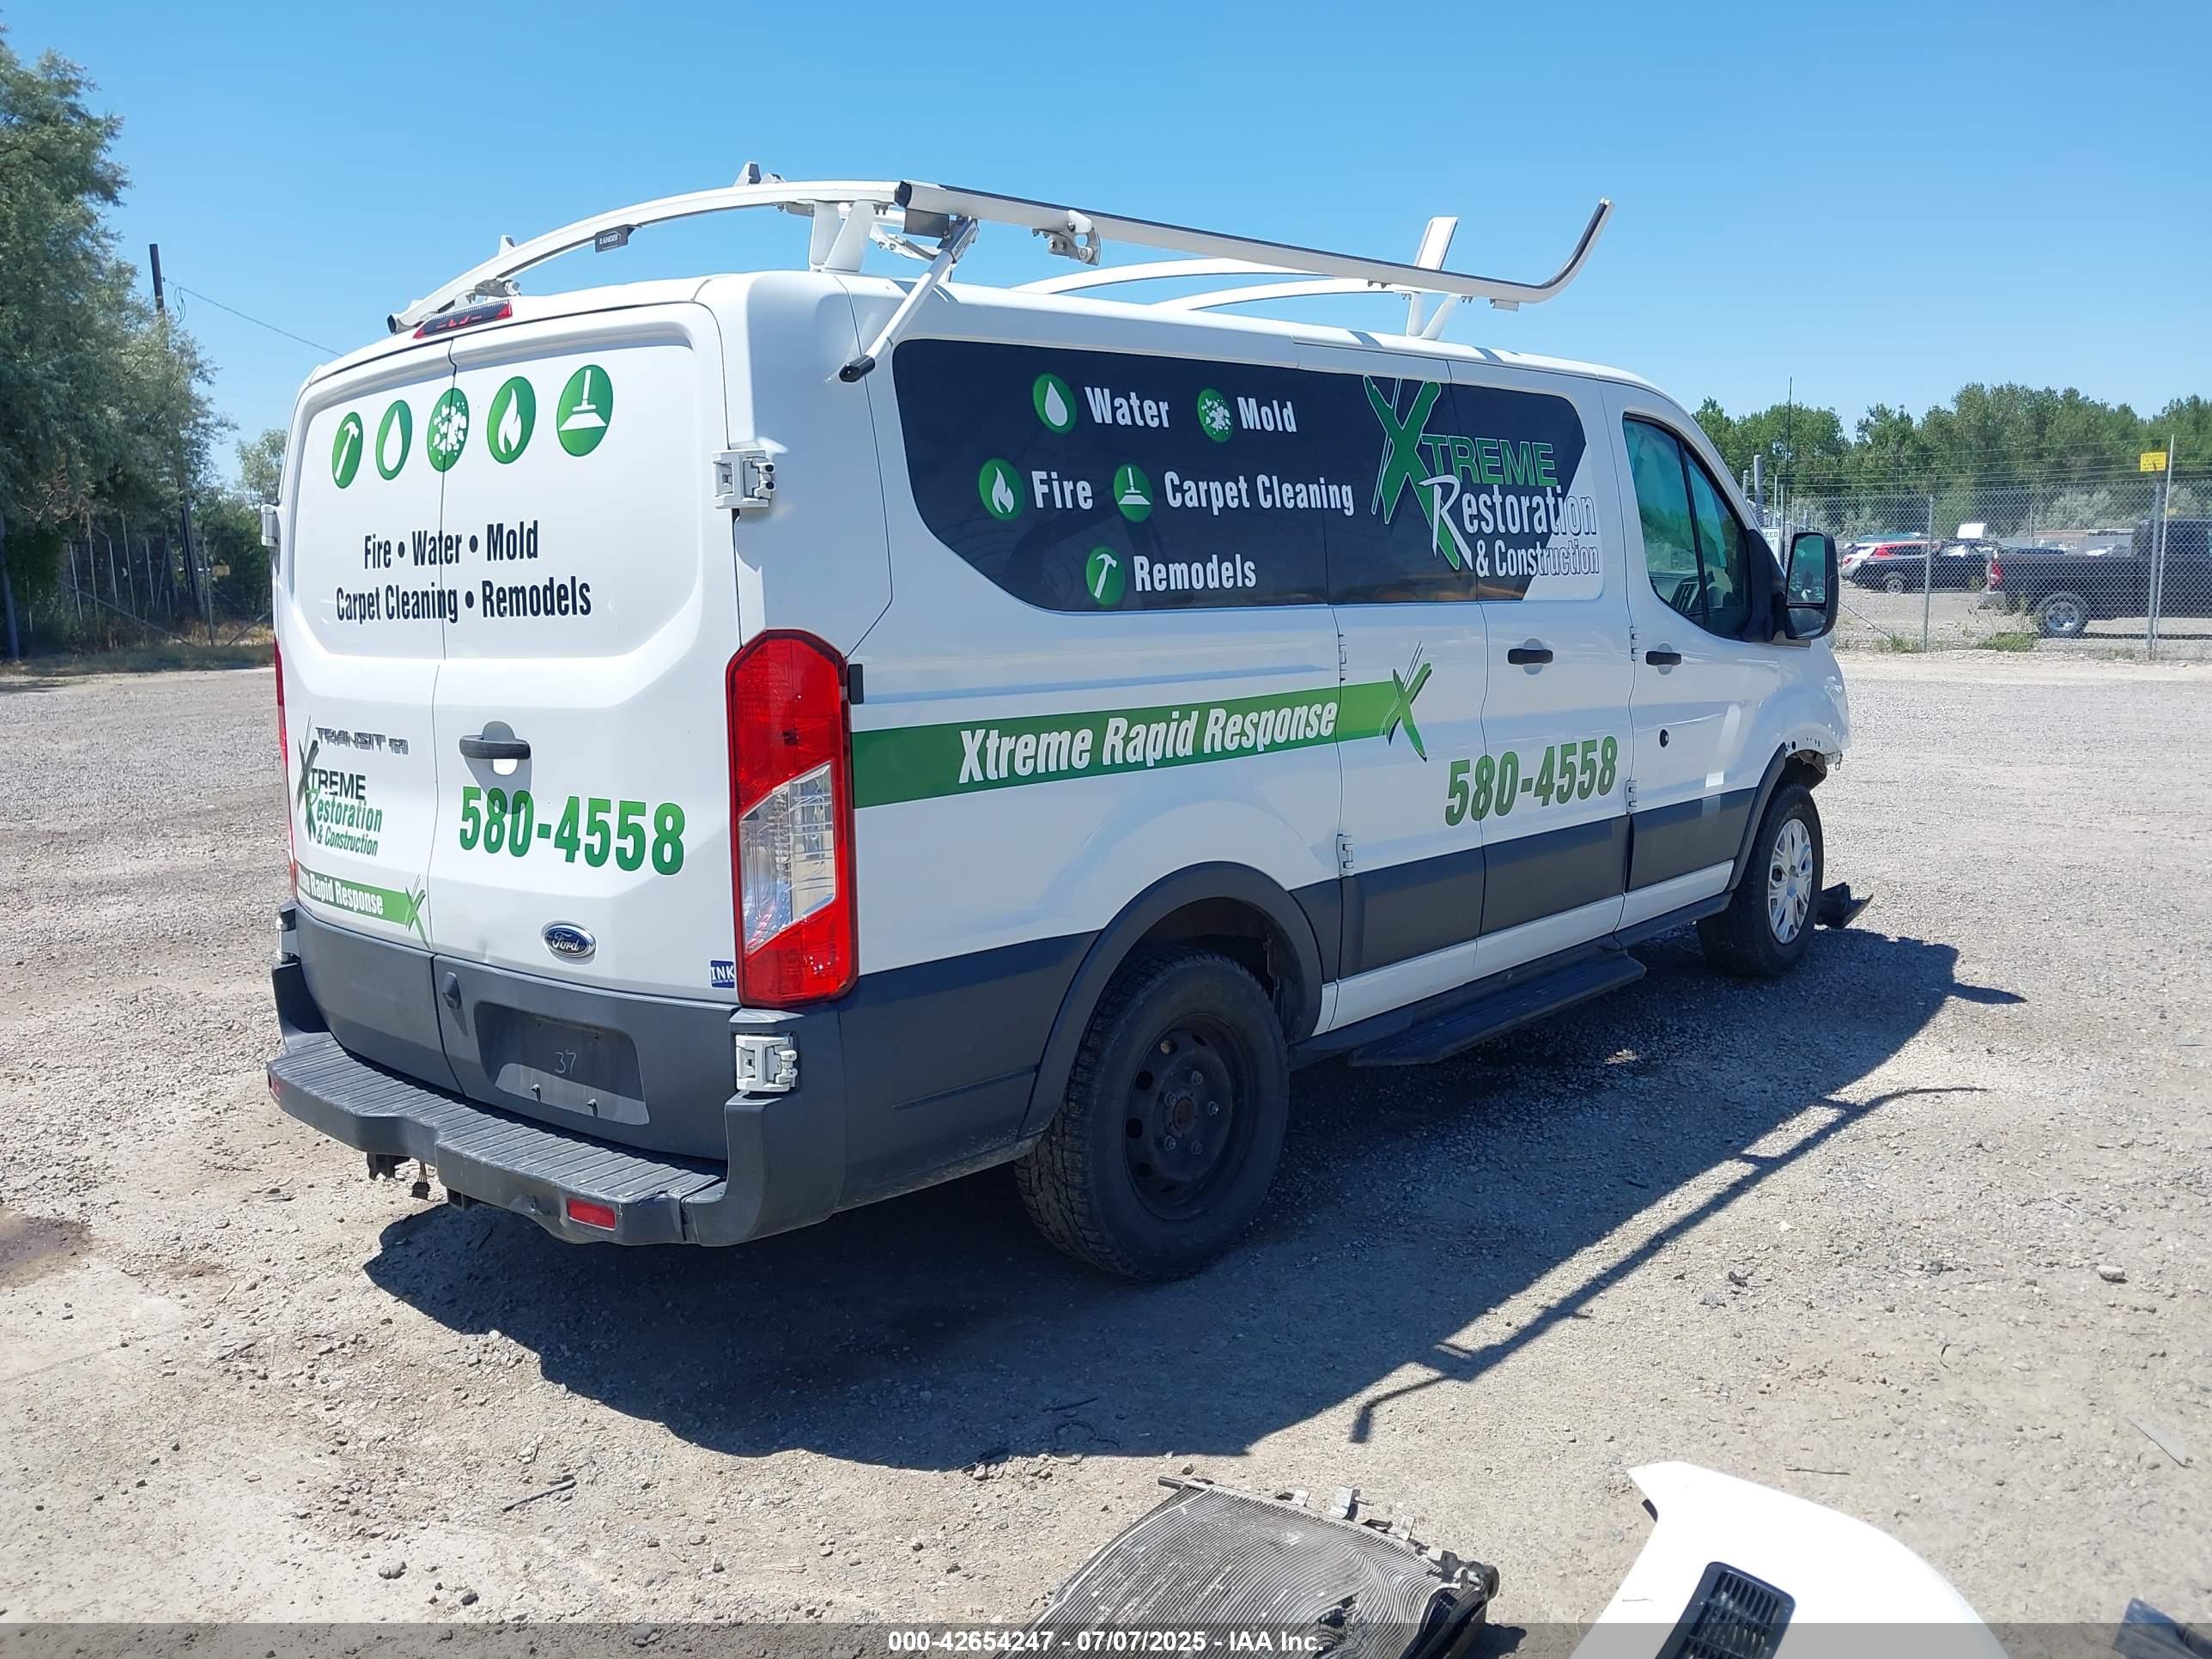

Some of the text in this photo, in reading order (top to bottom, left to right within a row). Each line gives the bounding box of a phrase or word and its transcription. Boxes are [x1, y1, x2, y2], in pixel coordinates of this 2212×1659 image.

[1085, 386, 1170, 428] Water
[1237, 397, 1297, 432] Mold
[1031, 471, 1093, 510] Fire
[1164, 471, 1355, 516] Carpet Cleaning
[1363, 374, 1559, 571] XTREME
[1418, 475, 1597, 571] Restoration
[364, 520, 538, 570] Fire Water Mold
[1476, 537, 1600, 578] & Construction
[1133, 554, 1257, 592] Remodels
[336, 575, 592, 624] Carpet Cleaning Remodels
[315, 726, 386, 751] TRANSIT
[958, 728, 1093, 784] Xtreme
[1102, 709, 1200, 767] Rapid
[1203, 701, 1338, 754] Response
[1444, 735, 1618, 826] 580-4558
[306, 788, 383, 839] Restoration
[459, 785, 685, 876] 580-4558
[317, 824, 379, 857] & Construction
[309, 872, 335, 902] Rapid
[335, 882, 384, 915] Response
[552, 932, 580, 951] Ford
[710, 965, 735, 981] INK
[555, 1049, 577, 1073] 37
